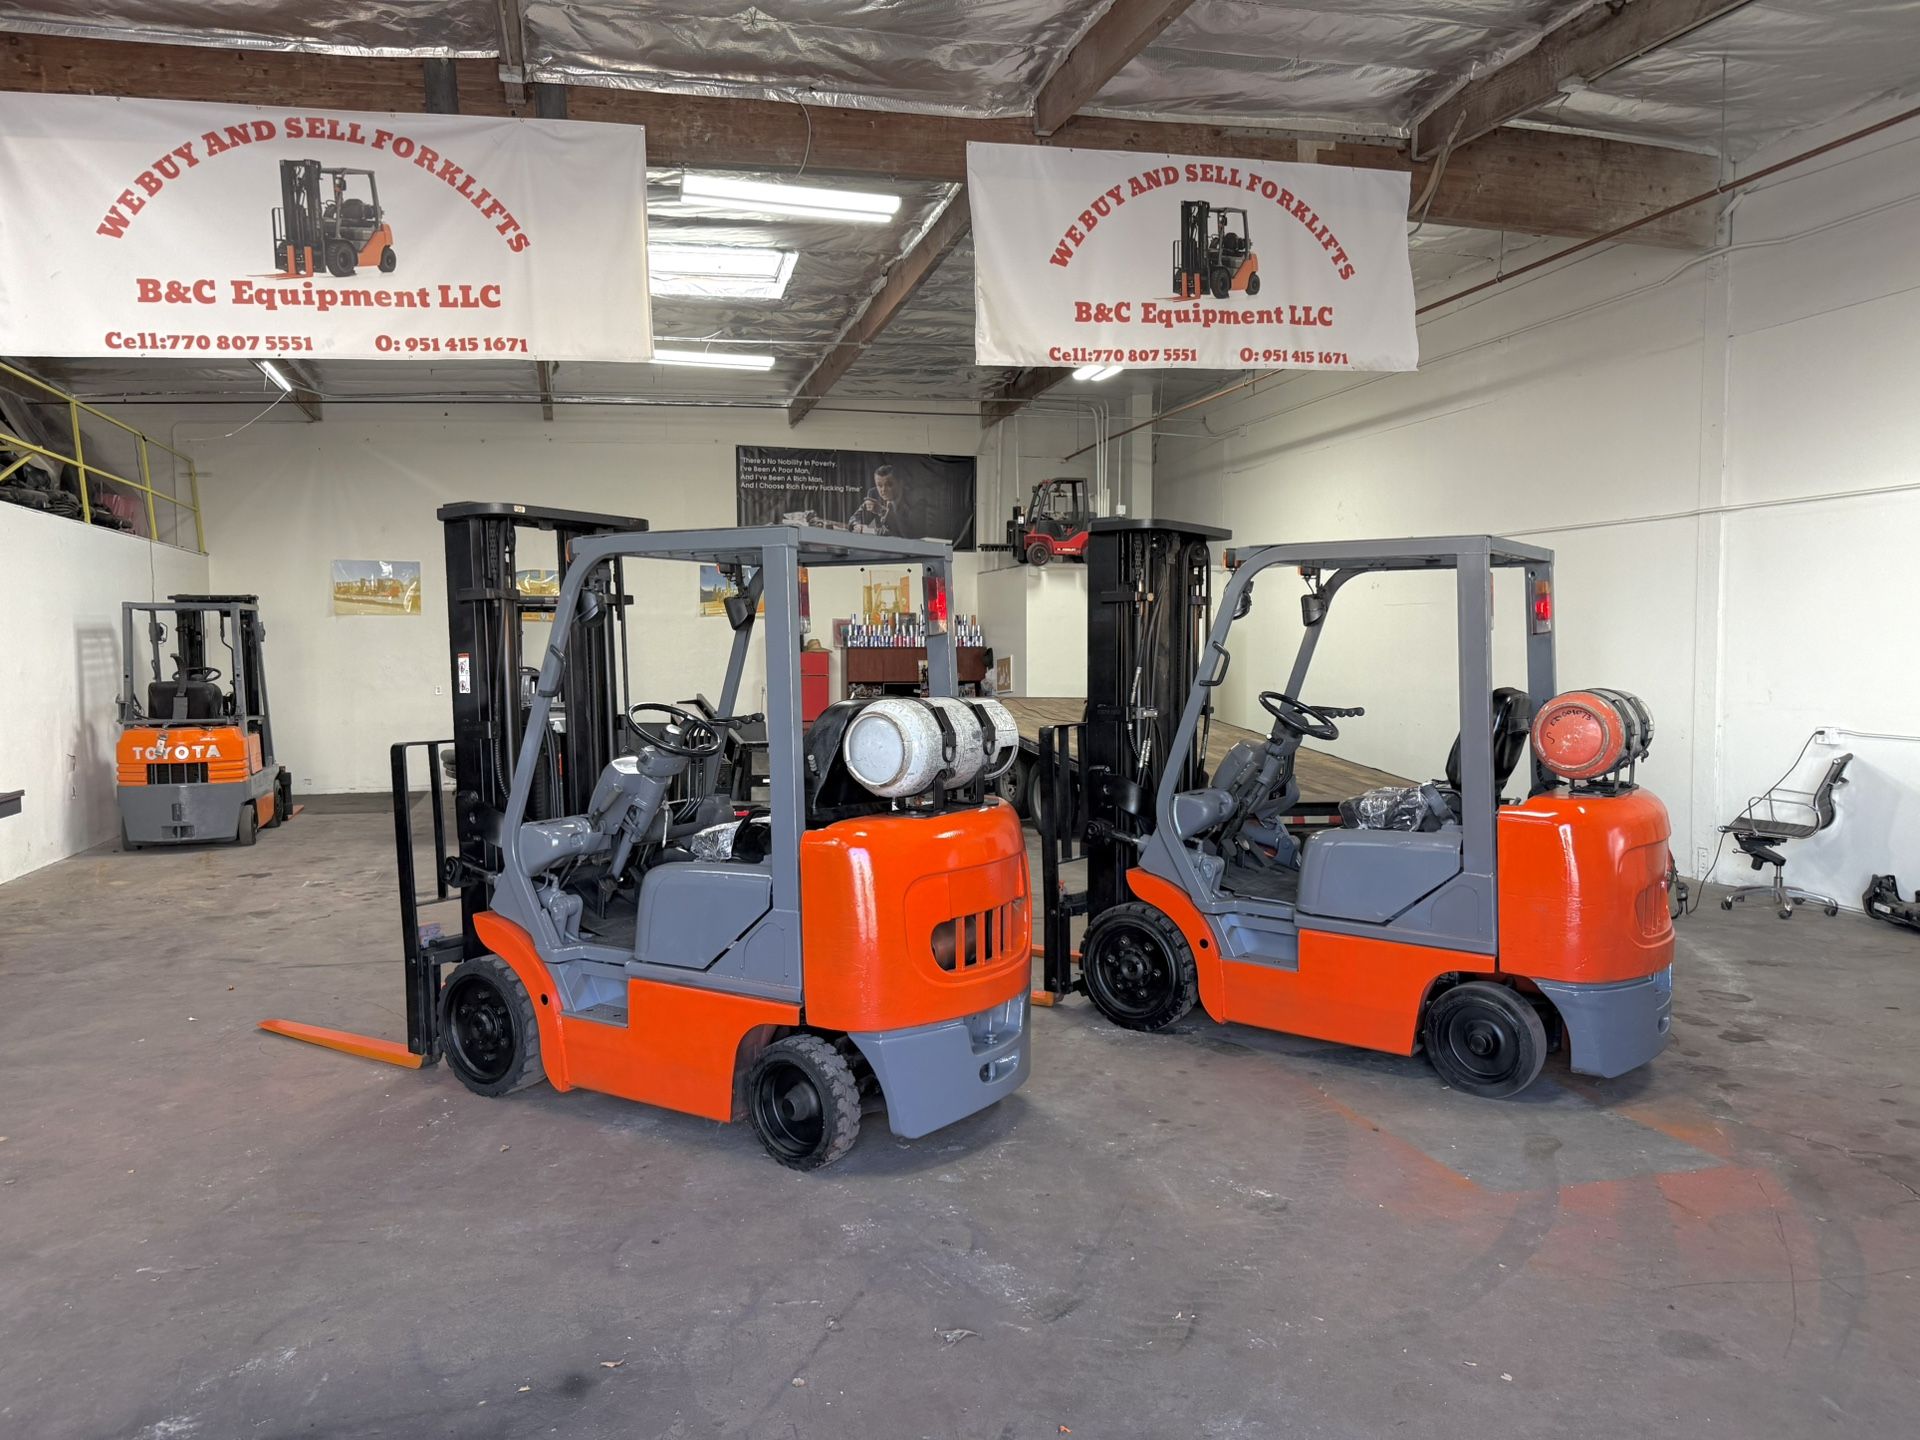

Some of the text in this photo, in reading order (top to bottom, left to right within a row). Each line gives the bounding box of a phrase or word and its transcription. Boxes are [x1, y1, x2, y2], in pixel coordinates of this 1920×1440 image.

[96, 117, 531, 254] WE BUY AND SELL FORKLIFTS
[1049, 163, 1356, 282] WE BUY AND SELL FORKLIFTS
[136, 277, 503, 313] B&C Equipment LLC
[1074, 300, 1334, 329] B&C Equipment LLC
[216, 335, 261, 352] 807
[264, 336, 314, 352] 5551
[374, 334, 529, 354] O: 951 415 1671
[1127, 348, 1161, 363] 807
[1163, 348, 1198, 363] 5551
[1239, 347, 1349, 365] O: 951 415 1671
[778, 459, 803, 467] Nobility
[740, 473, 755, 481] And
[740, 481, 754, 489] And
[759, 482, 785, 490] Choose
[801, 483, 818, 491] Every
[820, 484, 844, 493] Fucking
